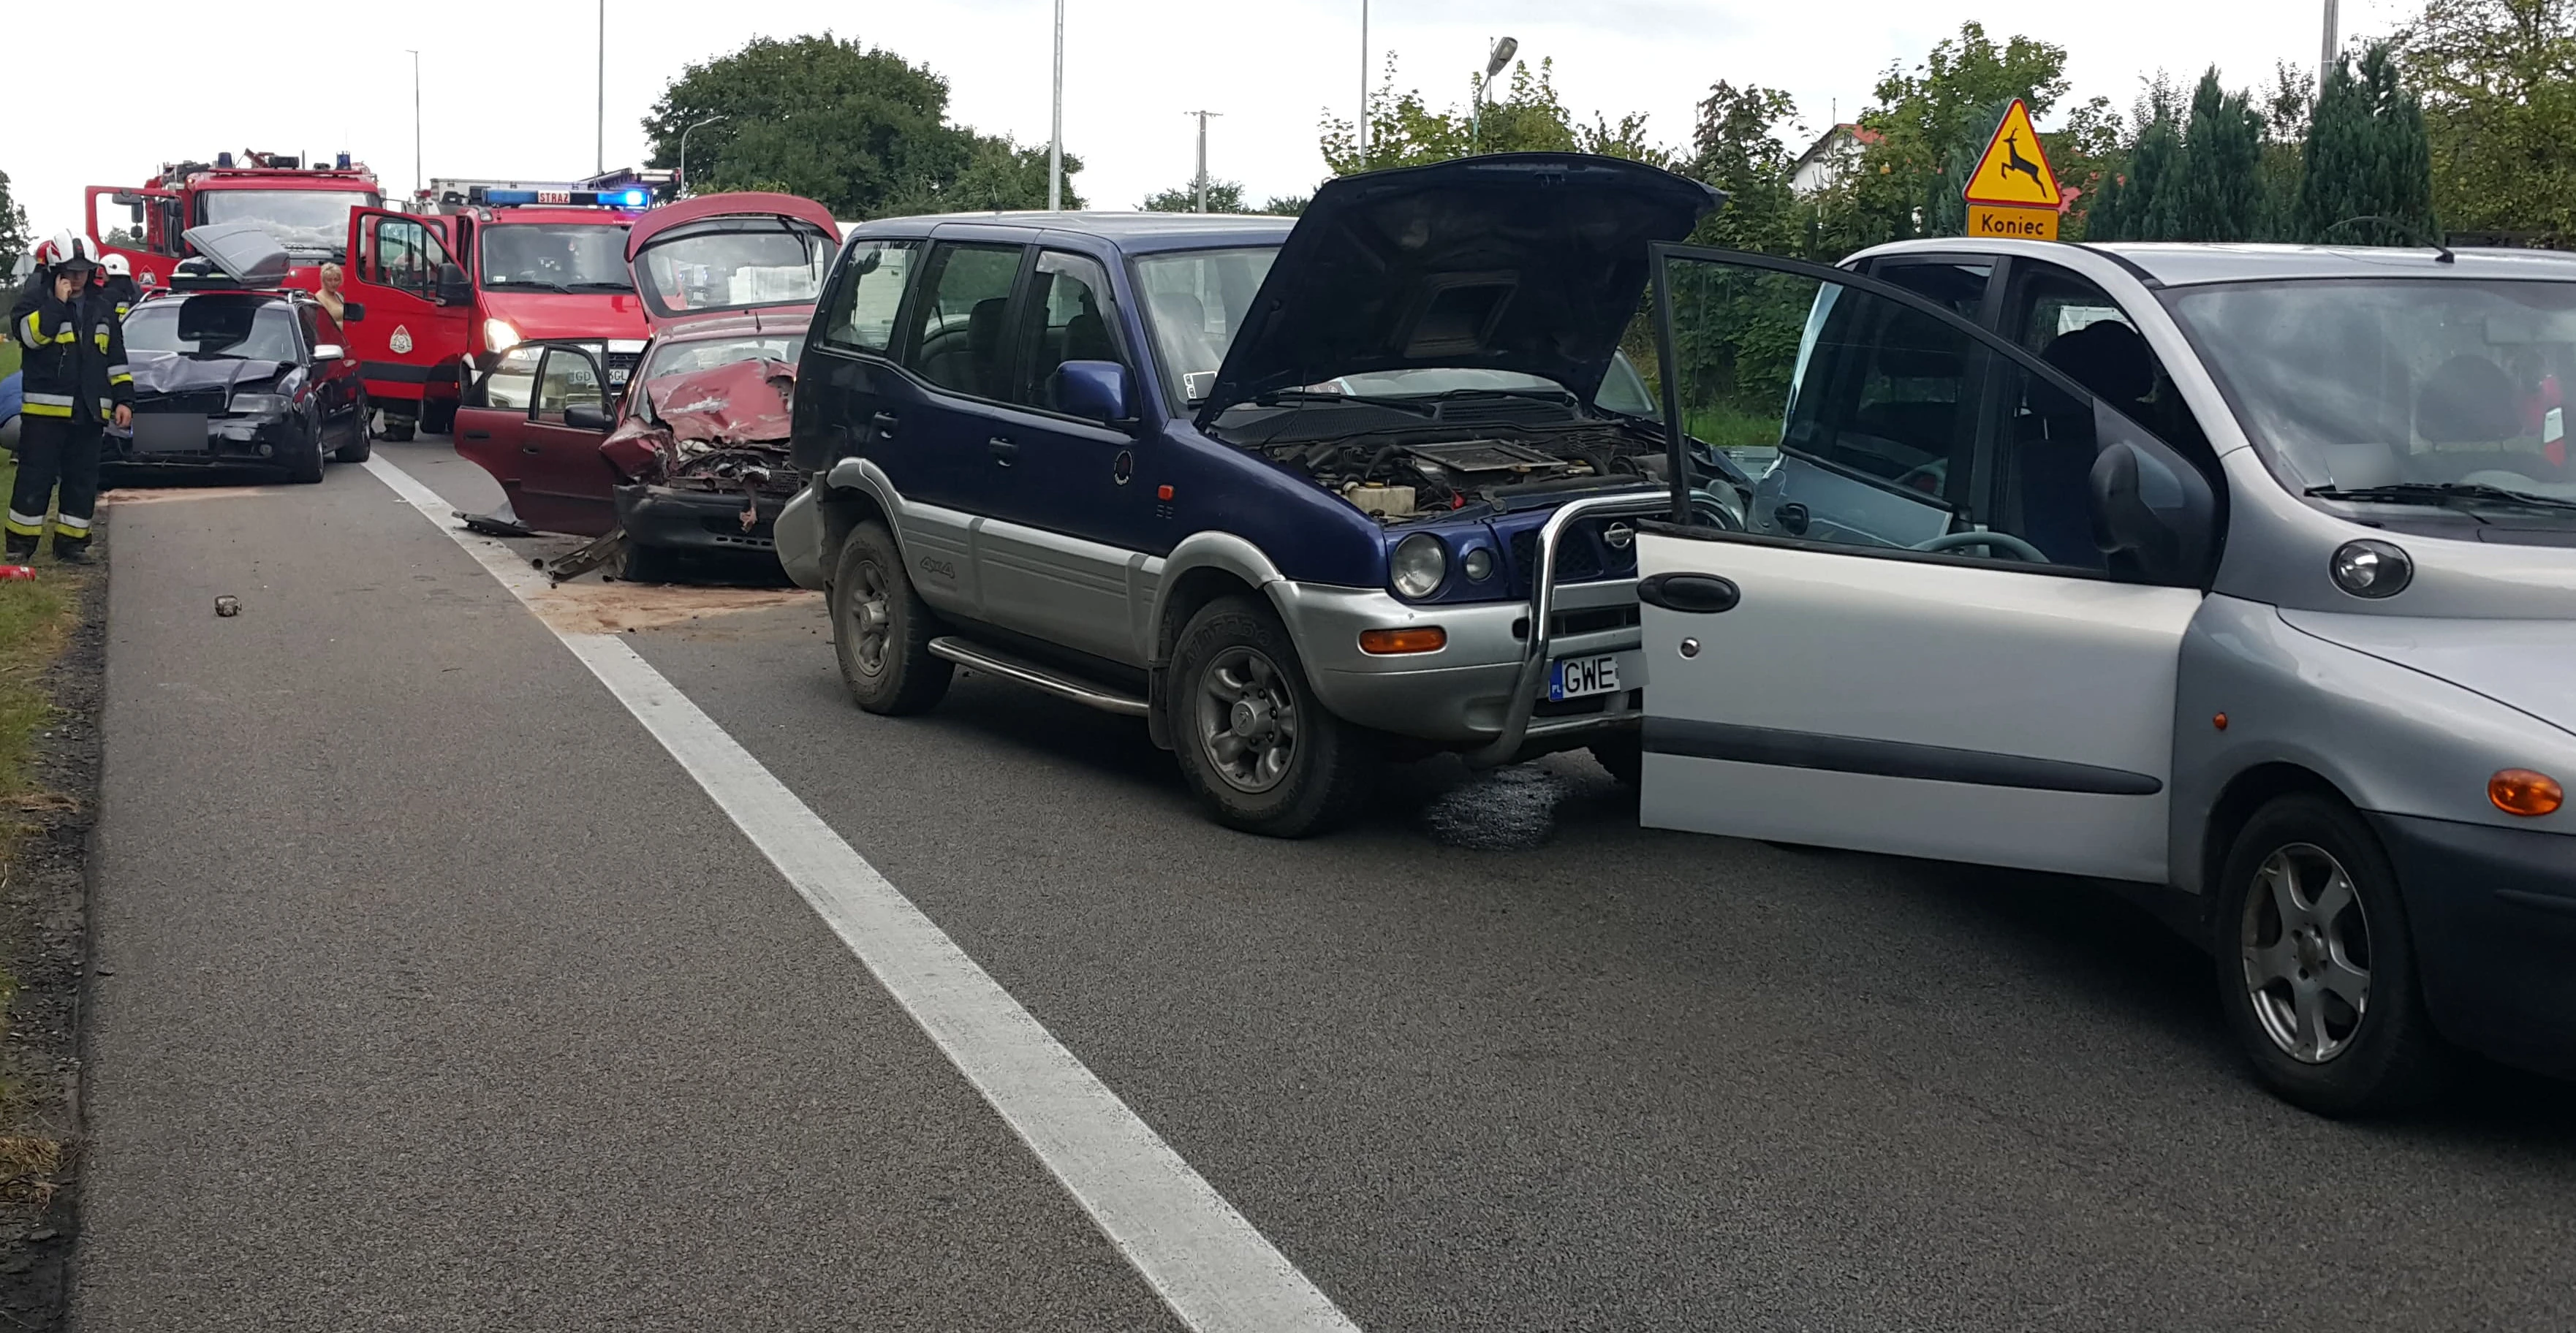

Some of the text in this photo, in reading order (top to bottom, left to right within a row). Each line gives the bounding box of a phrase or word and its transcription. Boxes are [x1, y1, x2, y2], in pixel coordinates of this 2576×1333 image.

[1981, 213, 2045, 235] Koniec
[575, 371, 591, 381] GD
[1564, 657, 1615, 693] GWE
[1551, 683, 1562, 694] PL
